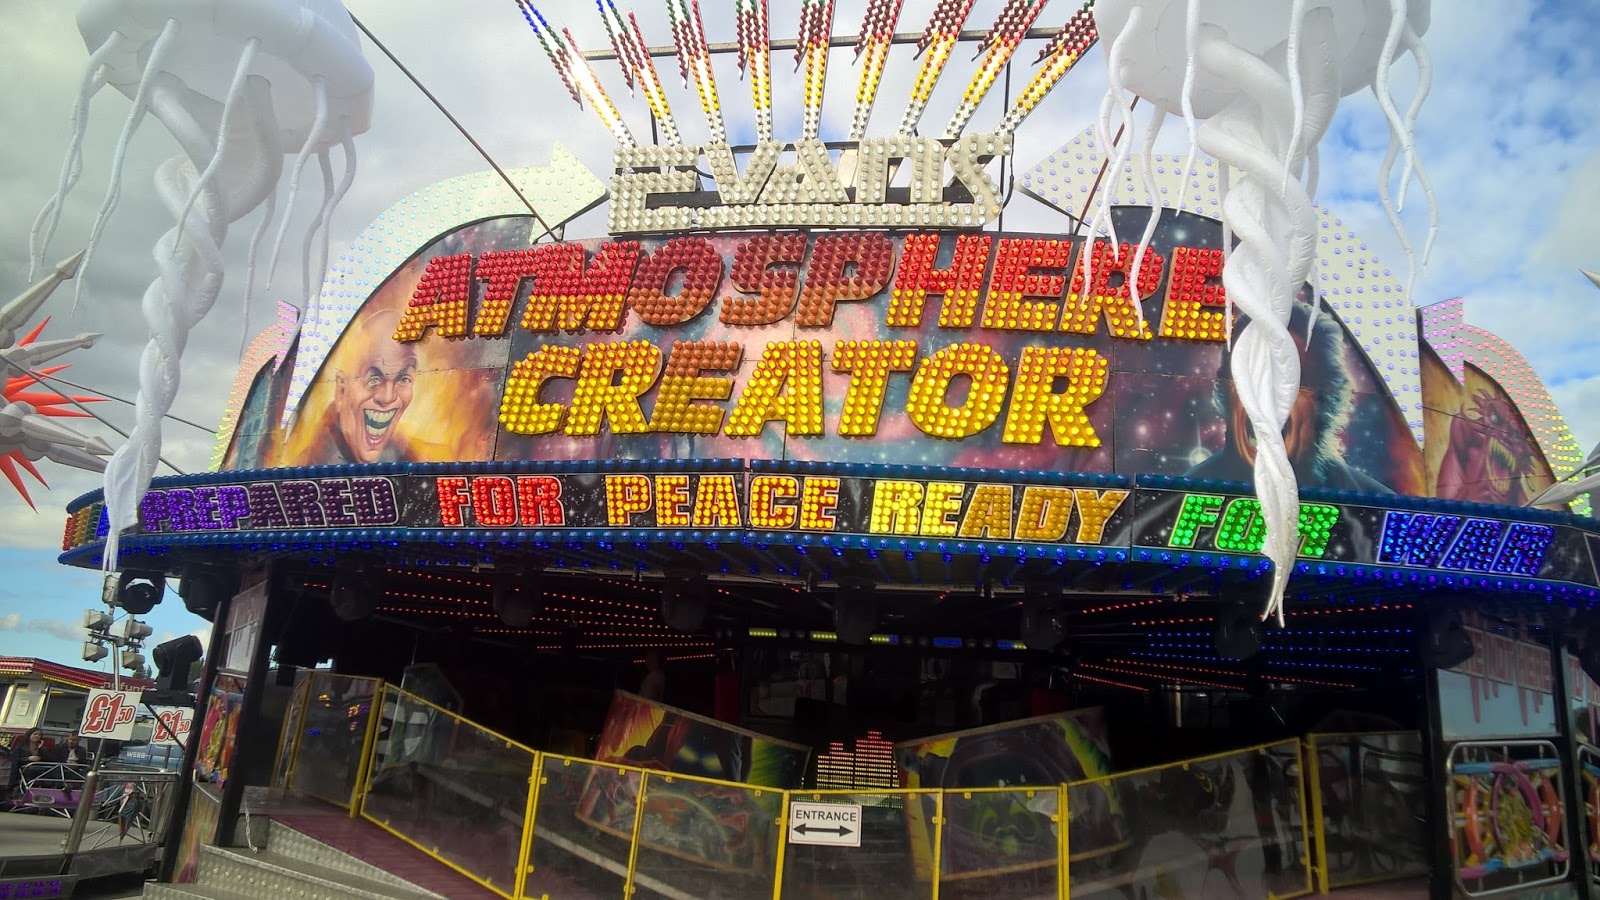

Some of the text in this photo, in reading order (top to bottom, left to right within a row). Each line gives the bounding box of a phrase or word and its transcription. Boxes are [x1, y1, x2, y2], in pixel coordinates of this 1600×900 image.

[606, 134, 1013, 233] EVANS
[391, 231, 1234, 342] ATMOSPHERE
[499, 339, 1109, 448] CREATOR
[142, 477, 399, 533] PREPARED
[436, 475, 565, 527] FOR
[605, 474, 840, 530] PEACE
[869, 480, 1130, 544] READY
[1167, 493, 1340, 558] FOR
[1376, 510, 1556, 577] WAR
[81, 692, 136, 734] £1.50
[795, 809, 857, 822] ENTRANCE
